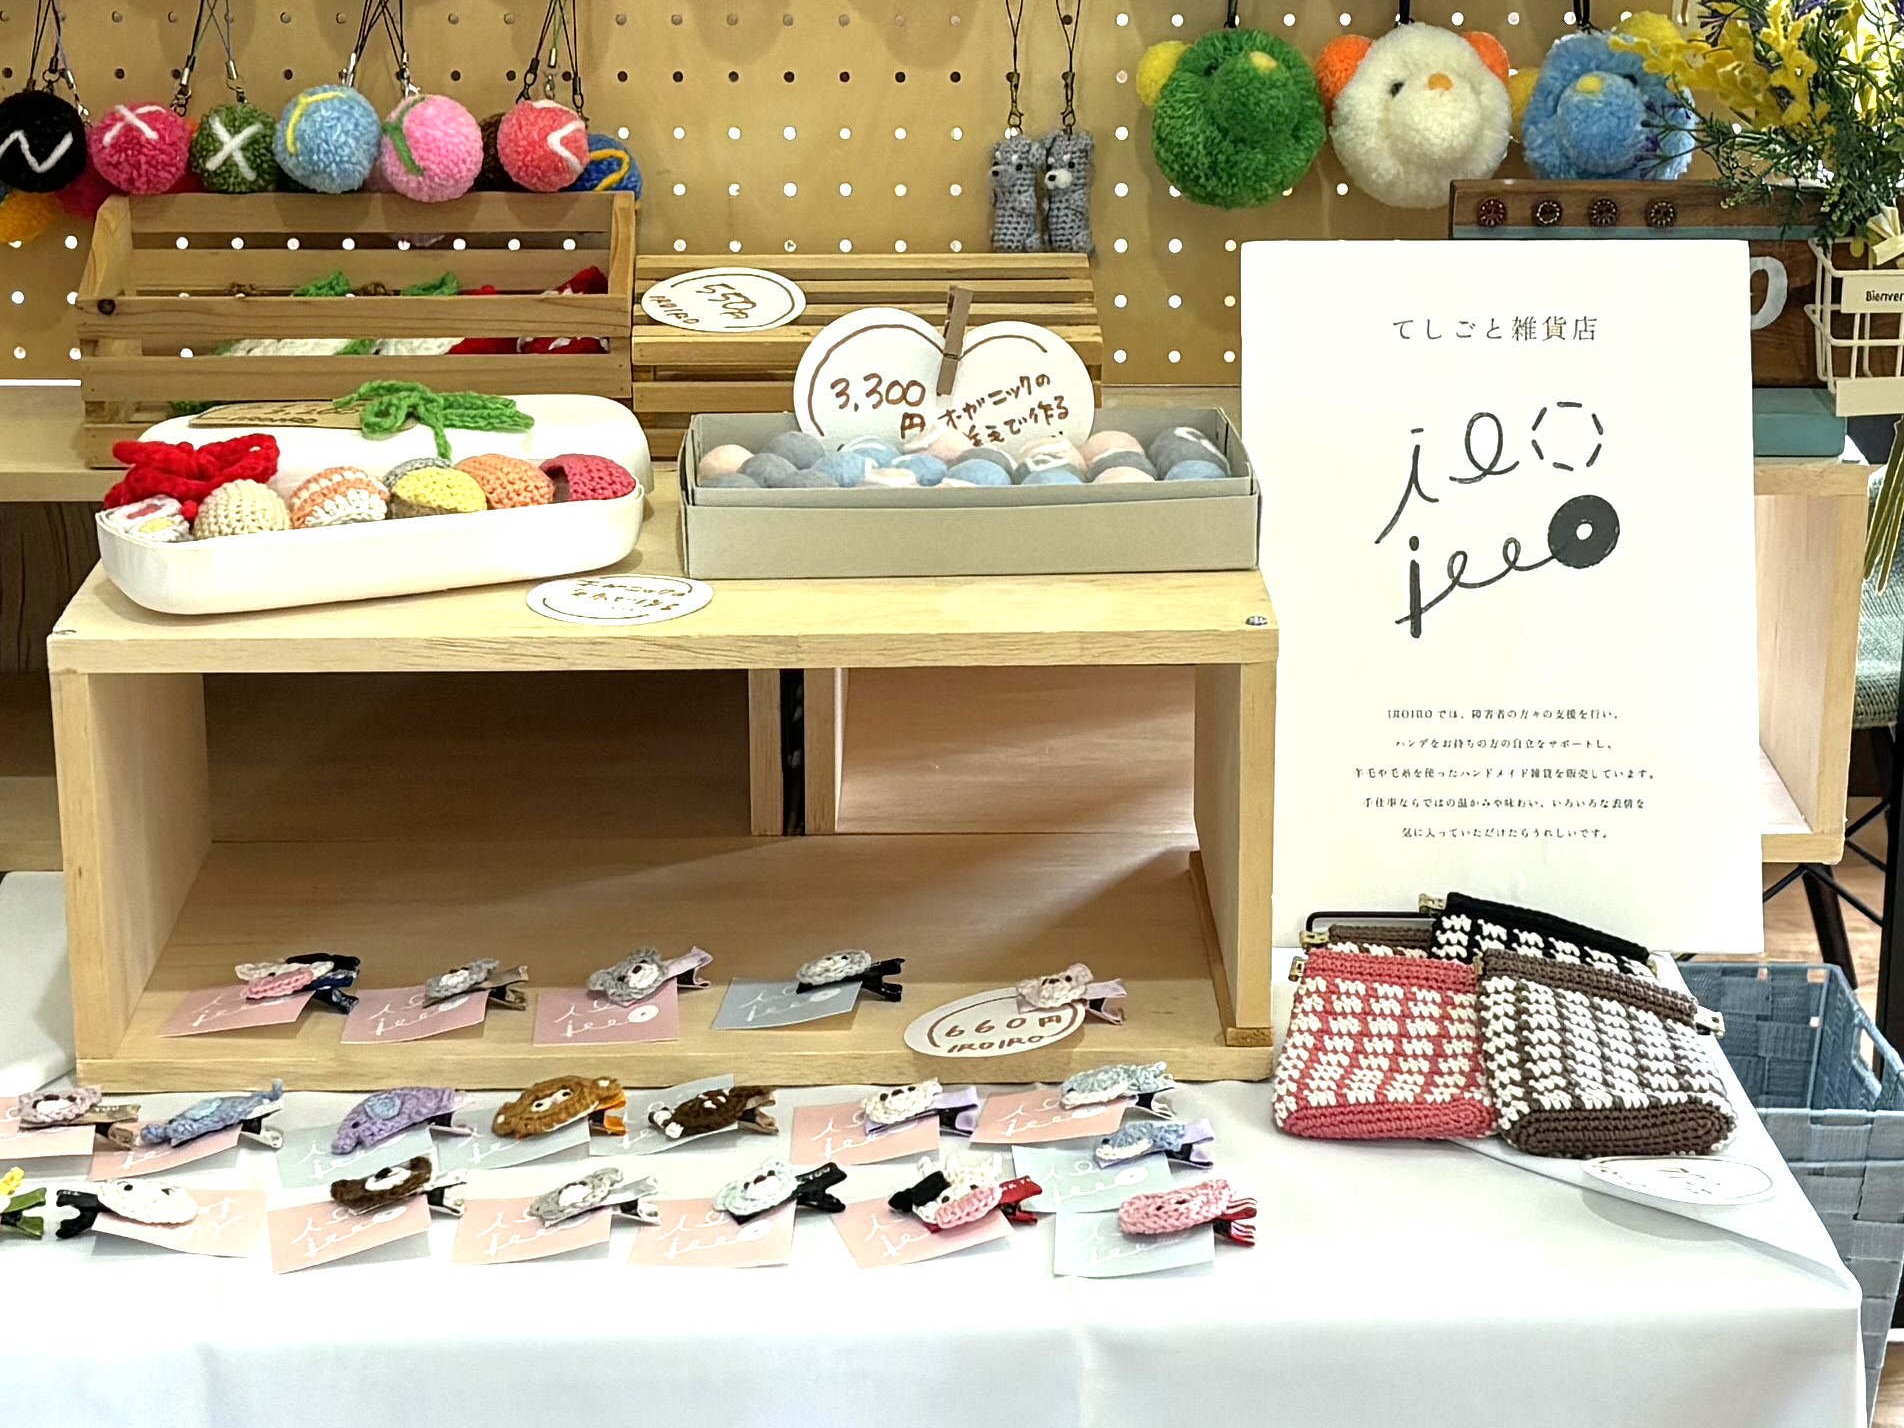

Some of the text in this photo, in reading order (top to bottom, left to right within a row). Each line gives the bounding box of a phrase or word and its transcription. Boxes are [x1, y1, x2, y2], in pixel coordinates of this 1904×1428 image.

[205, 115, 264, 181] X
[1392, 315, 1598, 342] てしごと雑貨店
[946, 1034, 1045, 1054] IROIRO
